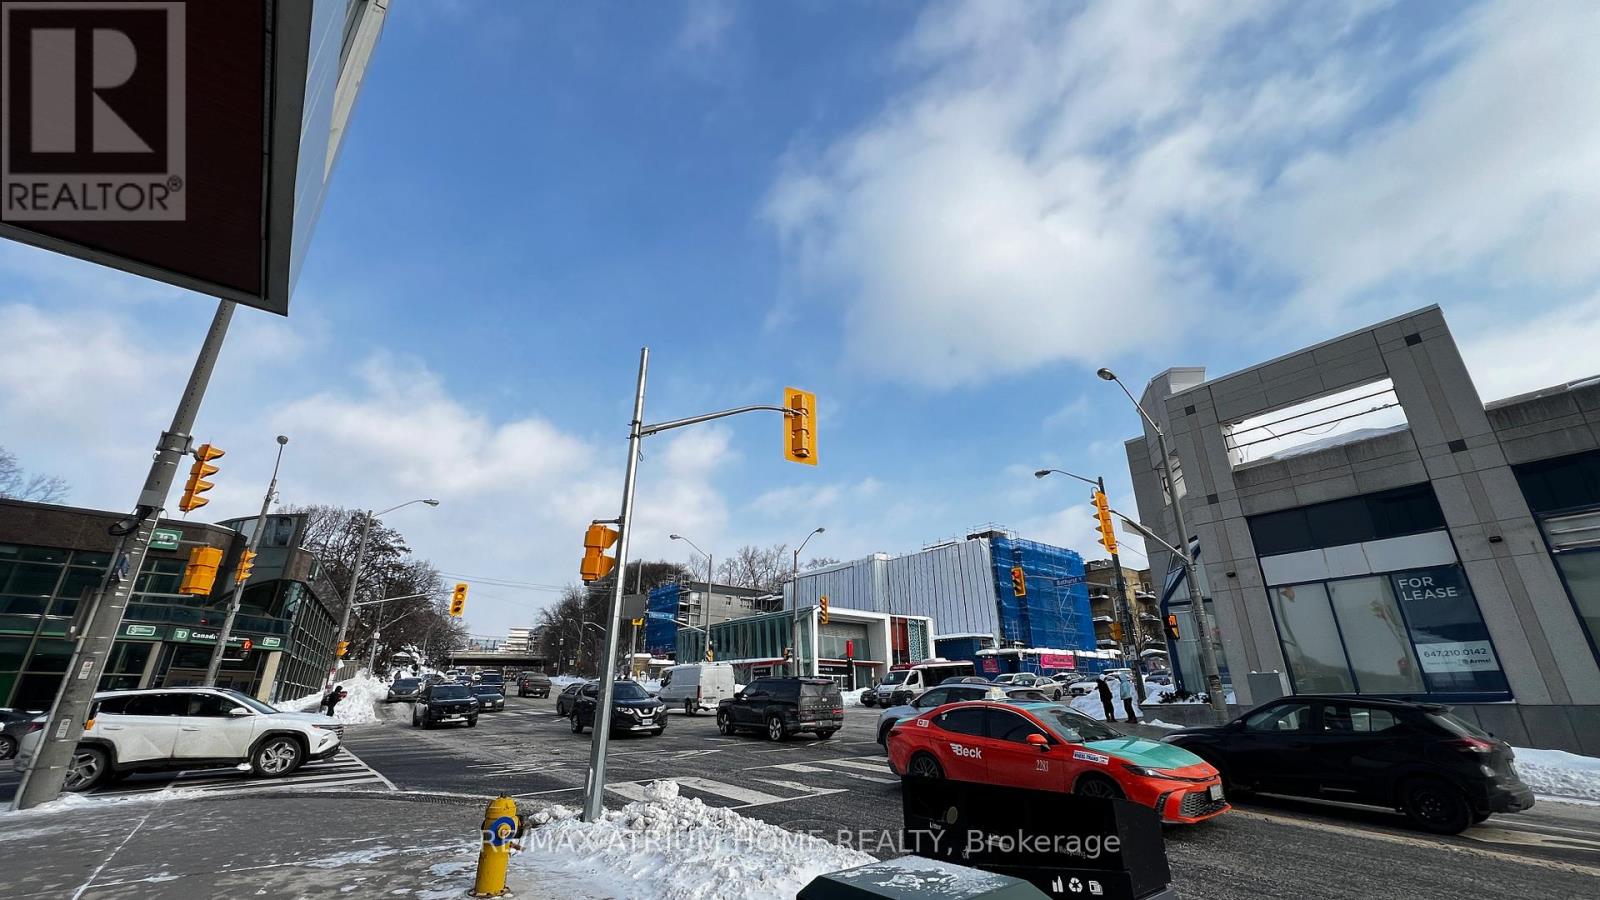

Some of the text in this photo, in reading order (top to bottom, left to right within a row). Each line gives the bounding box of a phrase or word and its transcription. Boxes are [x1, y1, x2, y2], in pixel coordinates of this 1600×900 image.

[1398, 576, 1435, 590] FOR
[1402, 586, 1458, 601] LEASE
[1423, 648, 1488, 658] 647.210.0142
[952, 743, 982, 760] Beck
